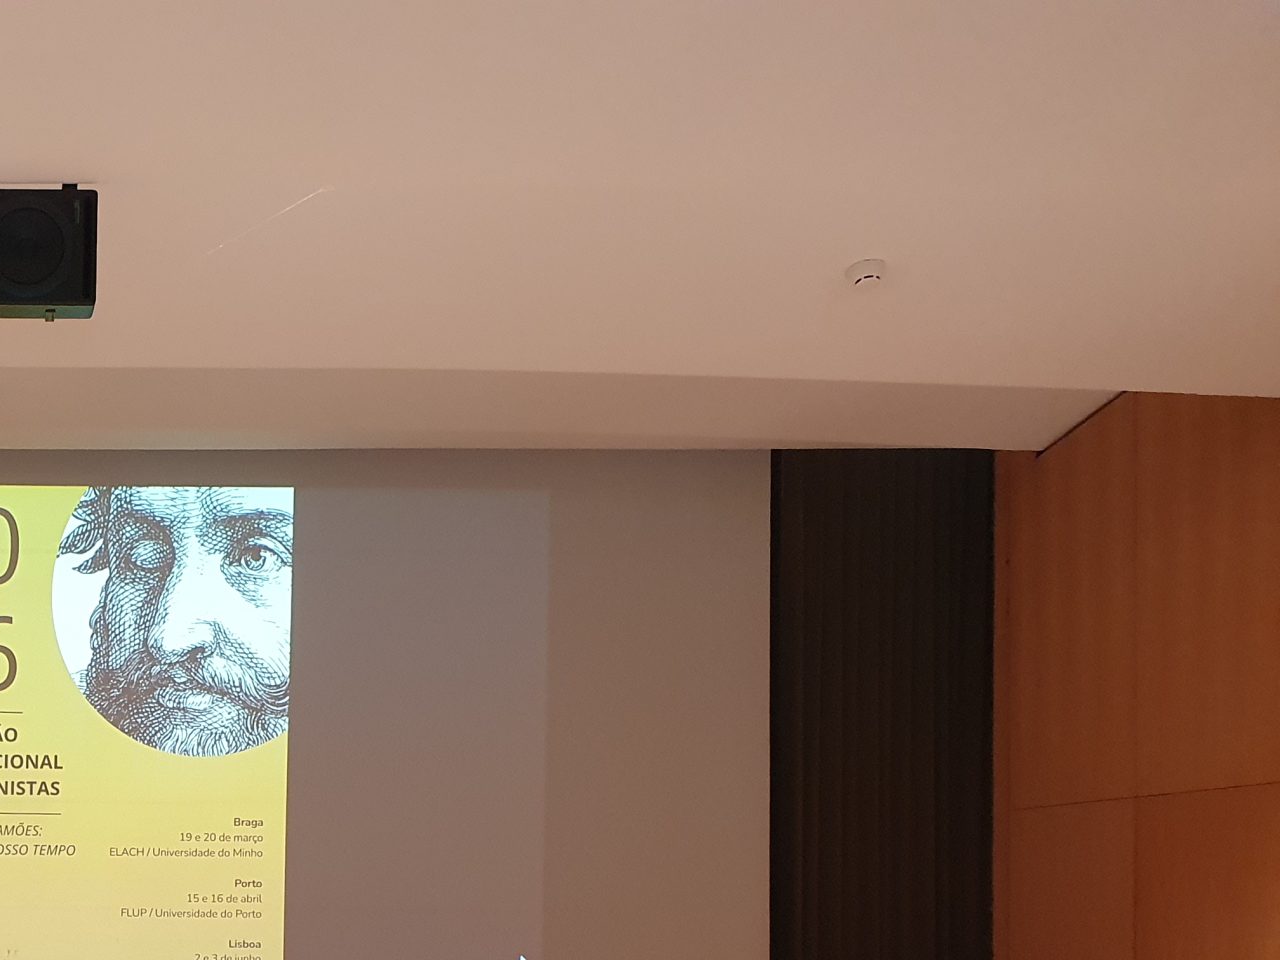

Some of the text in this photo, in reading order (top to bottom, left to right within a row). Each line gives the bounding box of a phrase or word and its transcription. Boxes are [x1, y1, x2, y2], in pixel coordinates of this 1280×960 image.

[233, 817, 264, 829] Braga
[179, 832, 264, 844] 19 e 20 de março
[32, 844, 76, 856] TEMPO
[109, 847, 263, 858] ELACH / Universidade do Minho
[234, 878, 263, 889] Porto
[187, 893, 199, 903] 15
[211, 893, 223, 904] 16
[225, 893, 238, 904] de
[240, 893, 263, 904] abril
[120, 907, 262, 920] FLUP / Universidade do Porto
[228, 939, 262, 950] Lisboa
